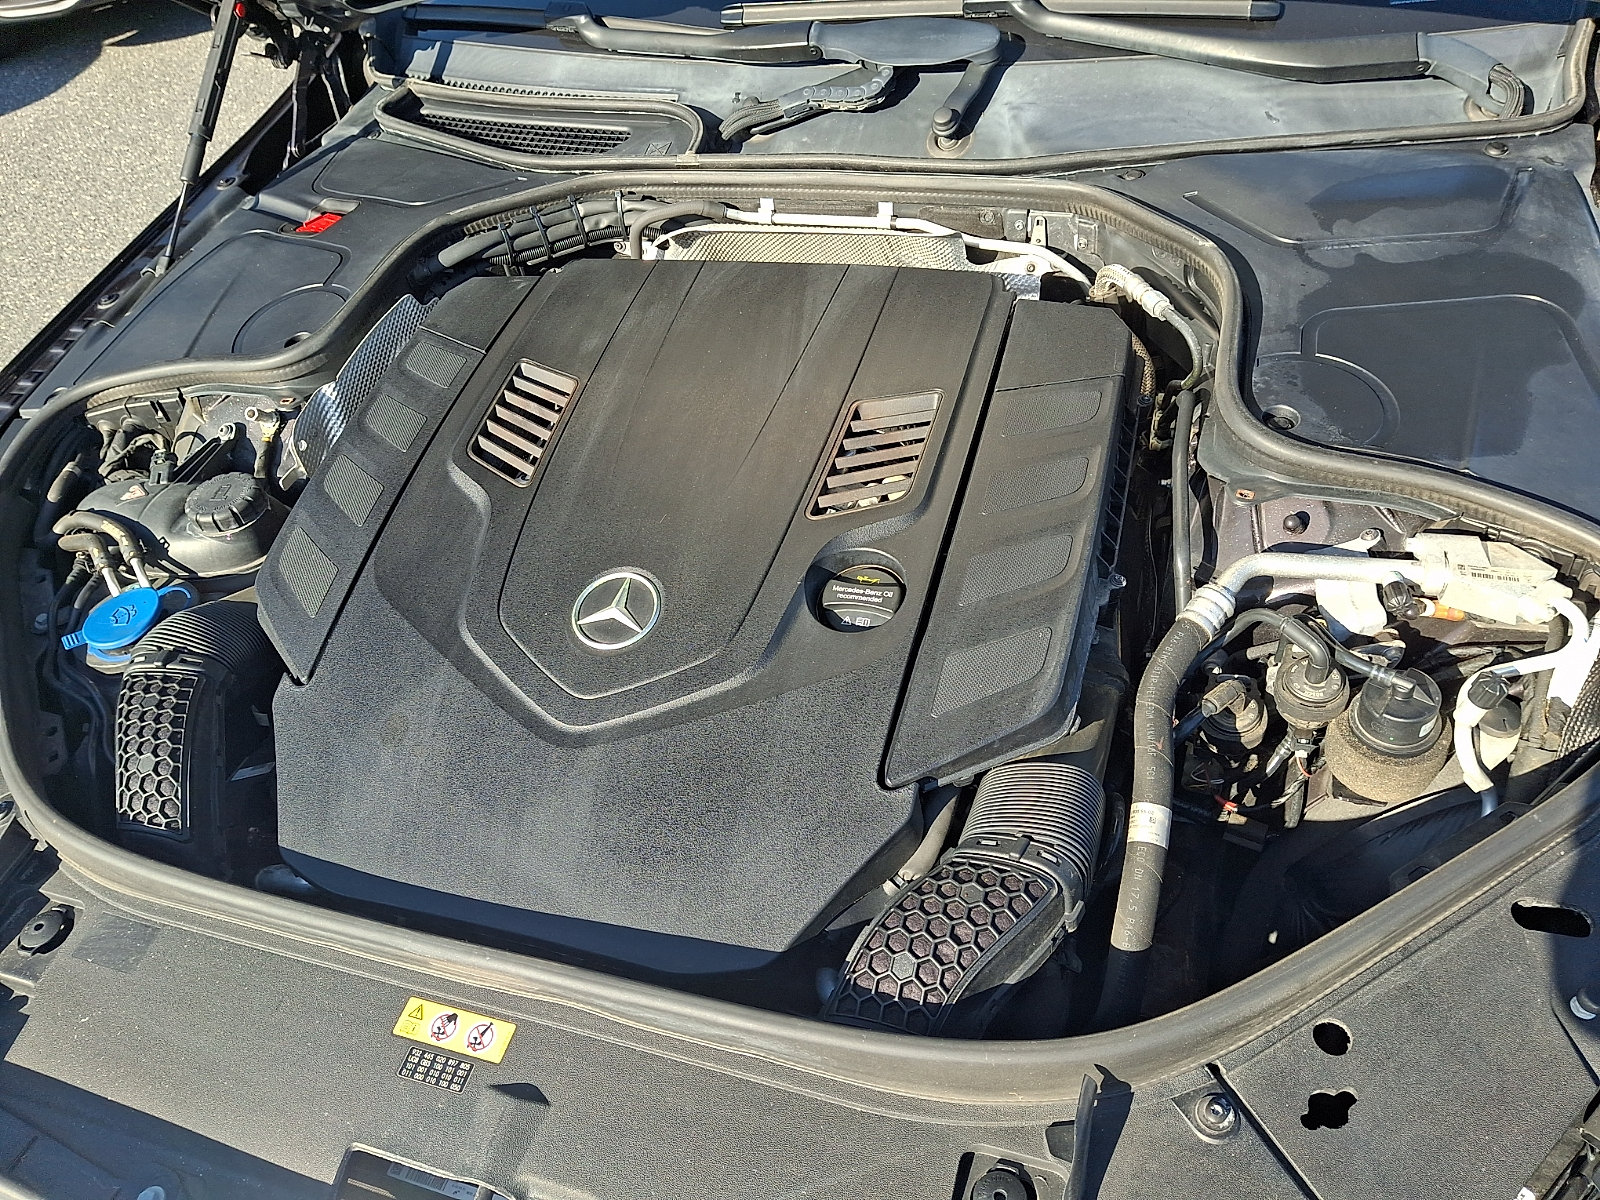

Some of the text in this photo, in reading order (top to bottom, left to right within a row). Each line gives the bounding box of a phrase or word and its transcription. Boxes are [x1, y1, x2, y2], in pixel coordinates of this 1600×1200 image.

[832, 585, 894, 598] Mercedes-Benz Oil
[836, 593, 883, 603] recommended
